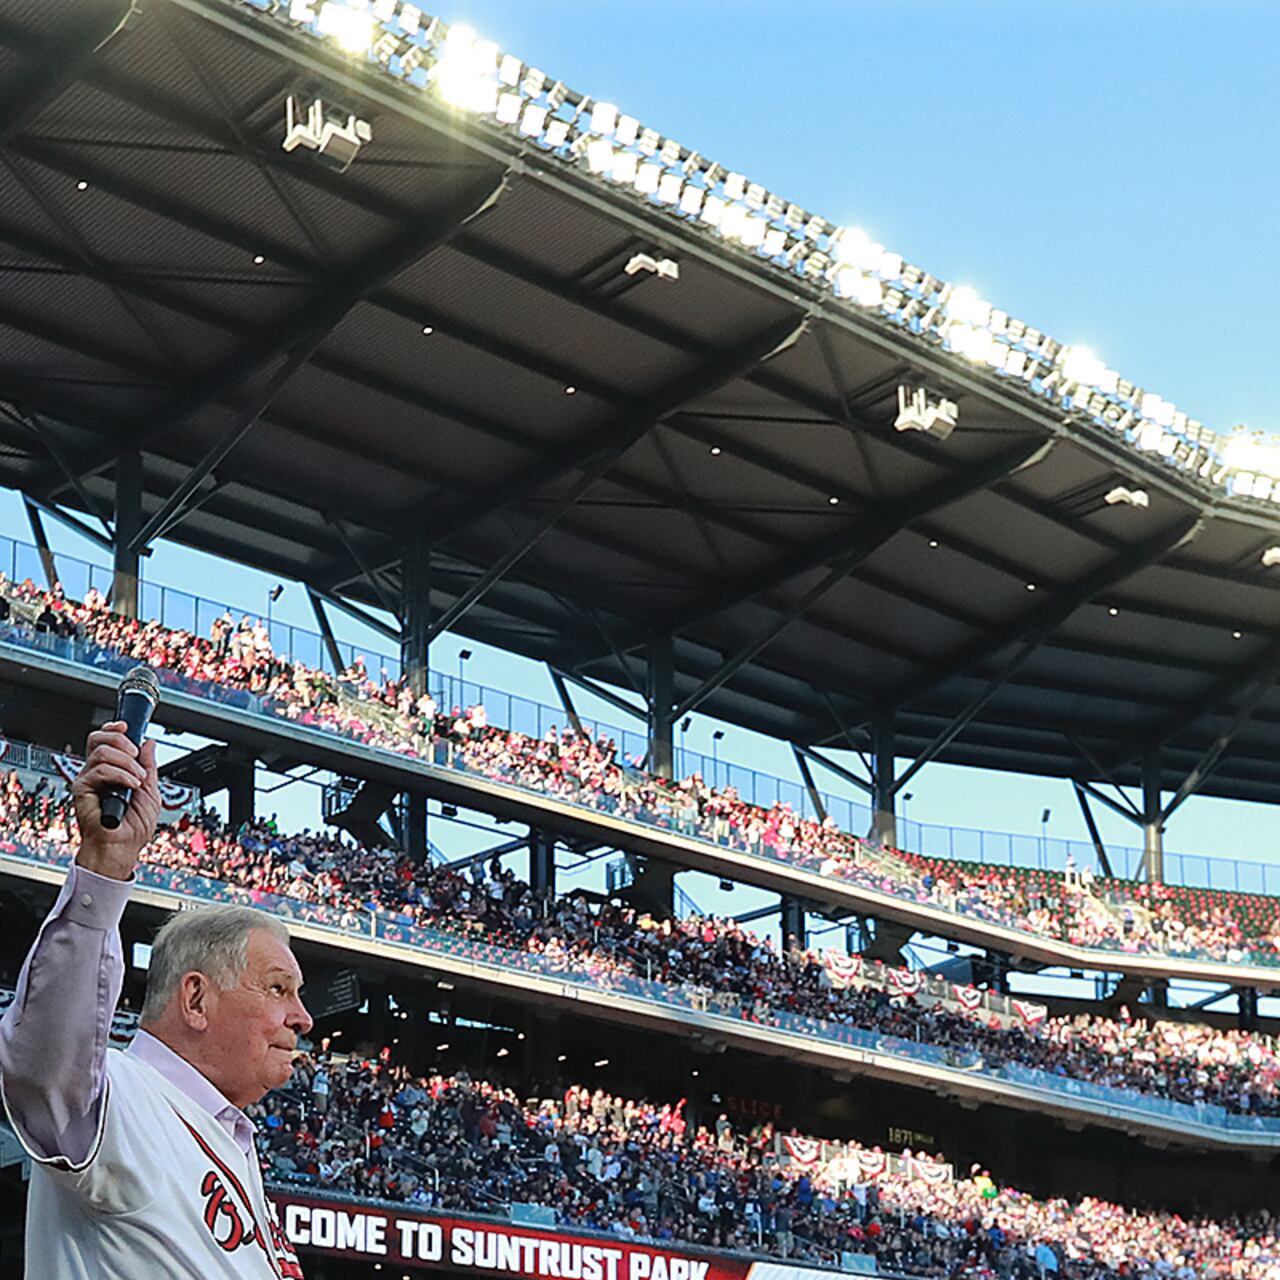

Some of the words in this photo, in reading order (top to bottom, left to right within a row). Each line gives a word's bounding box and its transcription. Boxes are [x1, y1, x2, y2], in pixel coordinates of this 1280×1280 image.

[888, 1127, 914, 1145] 1871
[270, 1202, 388, 1255] COME
[395, 1219, 442, 1262] TO
